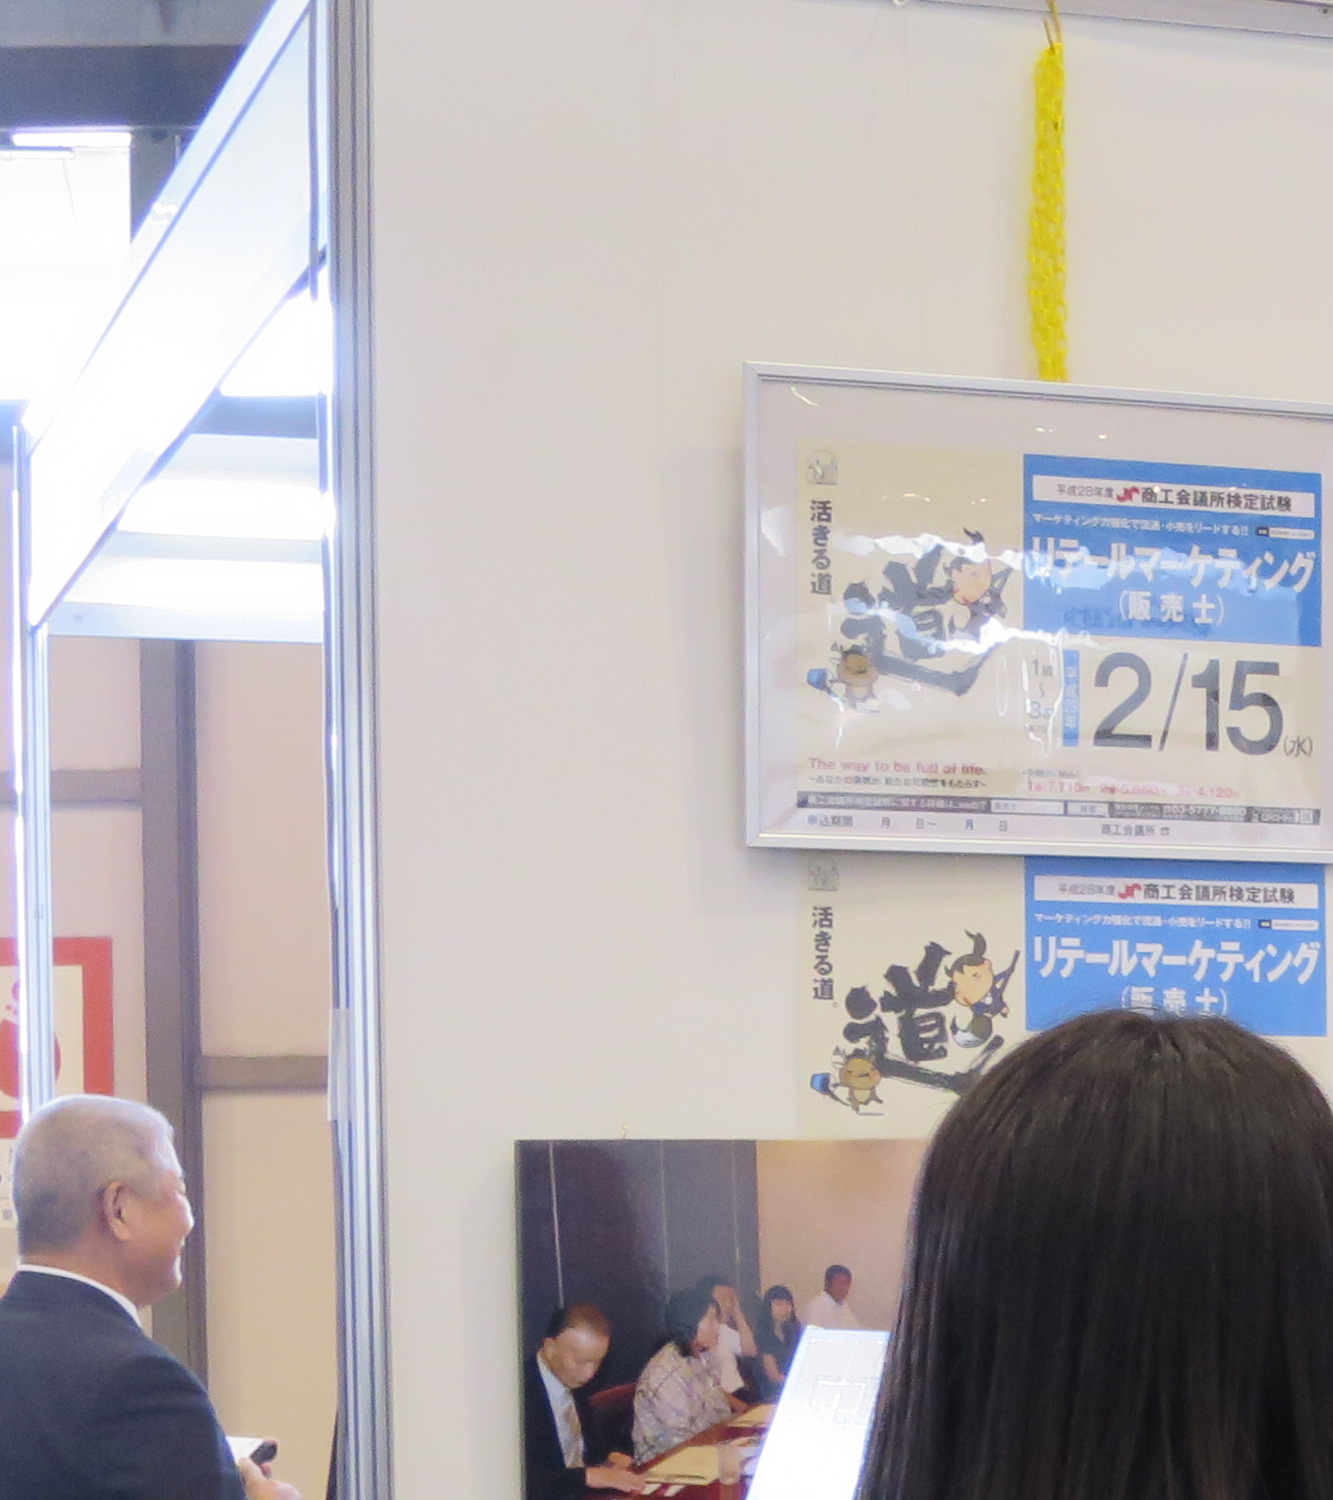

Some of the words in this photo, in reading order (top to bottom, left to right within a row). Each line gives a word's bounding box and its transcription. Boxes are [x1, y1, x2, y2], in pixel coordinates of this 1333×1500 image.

[1141, 486, 1292, 513] 商工会議所検定試験
[1026, 536, 1317, 593] リテールマーケティング
[1093, 651, 1284, 756] 2/15
[1283, 735, 1313, 757] (水)
[808, 758, 835, 770] The
[840, 761, 870, 773] way
[875, 761, 889, 772] to
[893, 761, 911, 773] be
[916, 762, 938, 774] full
[943, 763, 958, 774] of
[1143, 884, 1295, 905] 商工会議所検定試験
[1034, 934, 1321, 985] リテールマーケティング
